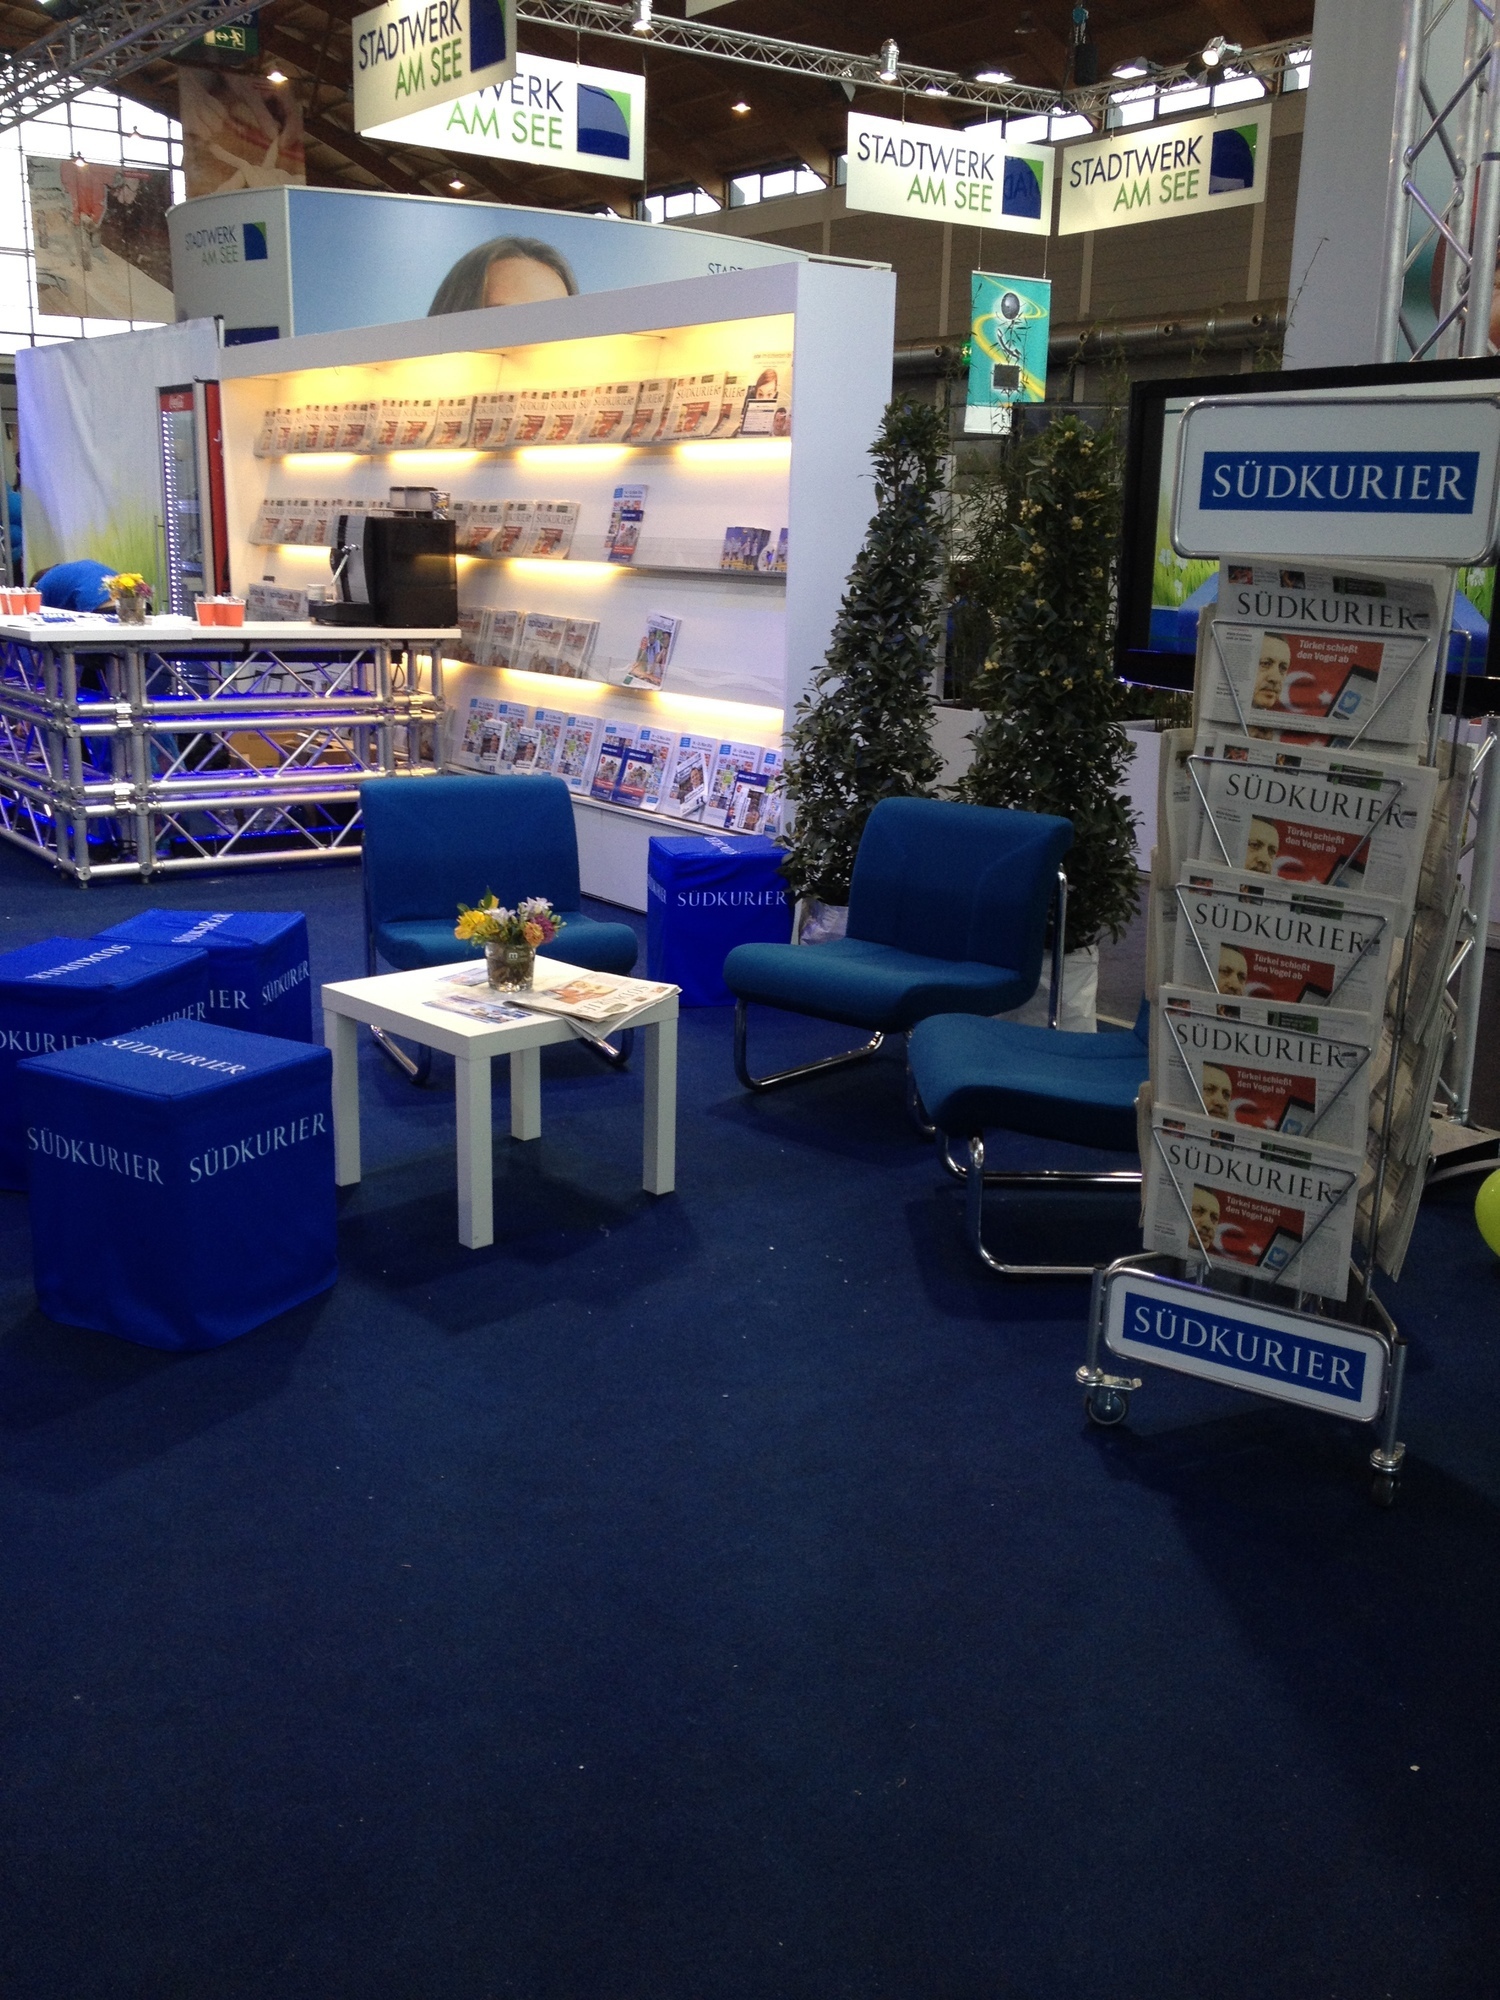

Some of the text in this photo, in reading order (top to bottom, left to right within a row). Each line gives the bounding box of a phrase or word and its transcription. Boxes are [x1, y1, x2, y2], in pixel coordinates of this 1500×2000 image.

[358, 0, 462, 70] STADTWERK
[395, 37, 462, 100] AM SEE
[447, 101, 563, 150] AM SEE
[857, 132, 995, 181] STADTWERK
[1070, 135, 1204, 188] STADTWERK
[907, 174, 946, 207] AM
[954, 180, 993, 212] SEE
[1113, 169, 1200, 212] AM SEE
[185, 225, 237, 251] STADTWERK
[202, 244, 238, 266] AM SEE
[1212, 461, 1467, 500] SÜDKURIER
[1237, 591, 1418, 631] SÜDKURIER
[1297, 650, 1349, 663] den Vogel ab
[1299, 640, 1359, 654] Türkei schießt
[1226, 773, 1405, 829] SÜDKURIER
[1285, 836, 1337, 853] den Vogel ab
[1287, 826, 1345, 845] Türkei schießt
[677, 890, 788, 906] SÜDKURIER
[1194, 903, 1368, 956] SÜDKURIER
[262, 959, 310, 1005] SÜDKURIER
[1253, 964, 1303, 980] den Vogel ab
[1254, 953, 1310, 972] Türkei schießt
[102, 1038, 247, 1075] SÜDKURIER
[1176, 1023, 1348, 1069] SÜDKURIER
[1237, 1071, 1292, 1086] Türkei schießt
[1237, 1080, 1286, 1095] den Vogel ab
[27, 1127, 164, 1185] SÜDKURIER
[190, 1112, 326, 1183] SÜDKURIER
[1168, 1145, 1334, 1204] SÜDKURIER
[1225, 1205, 1274, 1224] den Vogel ab
[1227, 1196, 1280, 1216] Türkei schießt
[1134, 1308, 1356, 1390] SÜDKURIER
